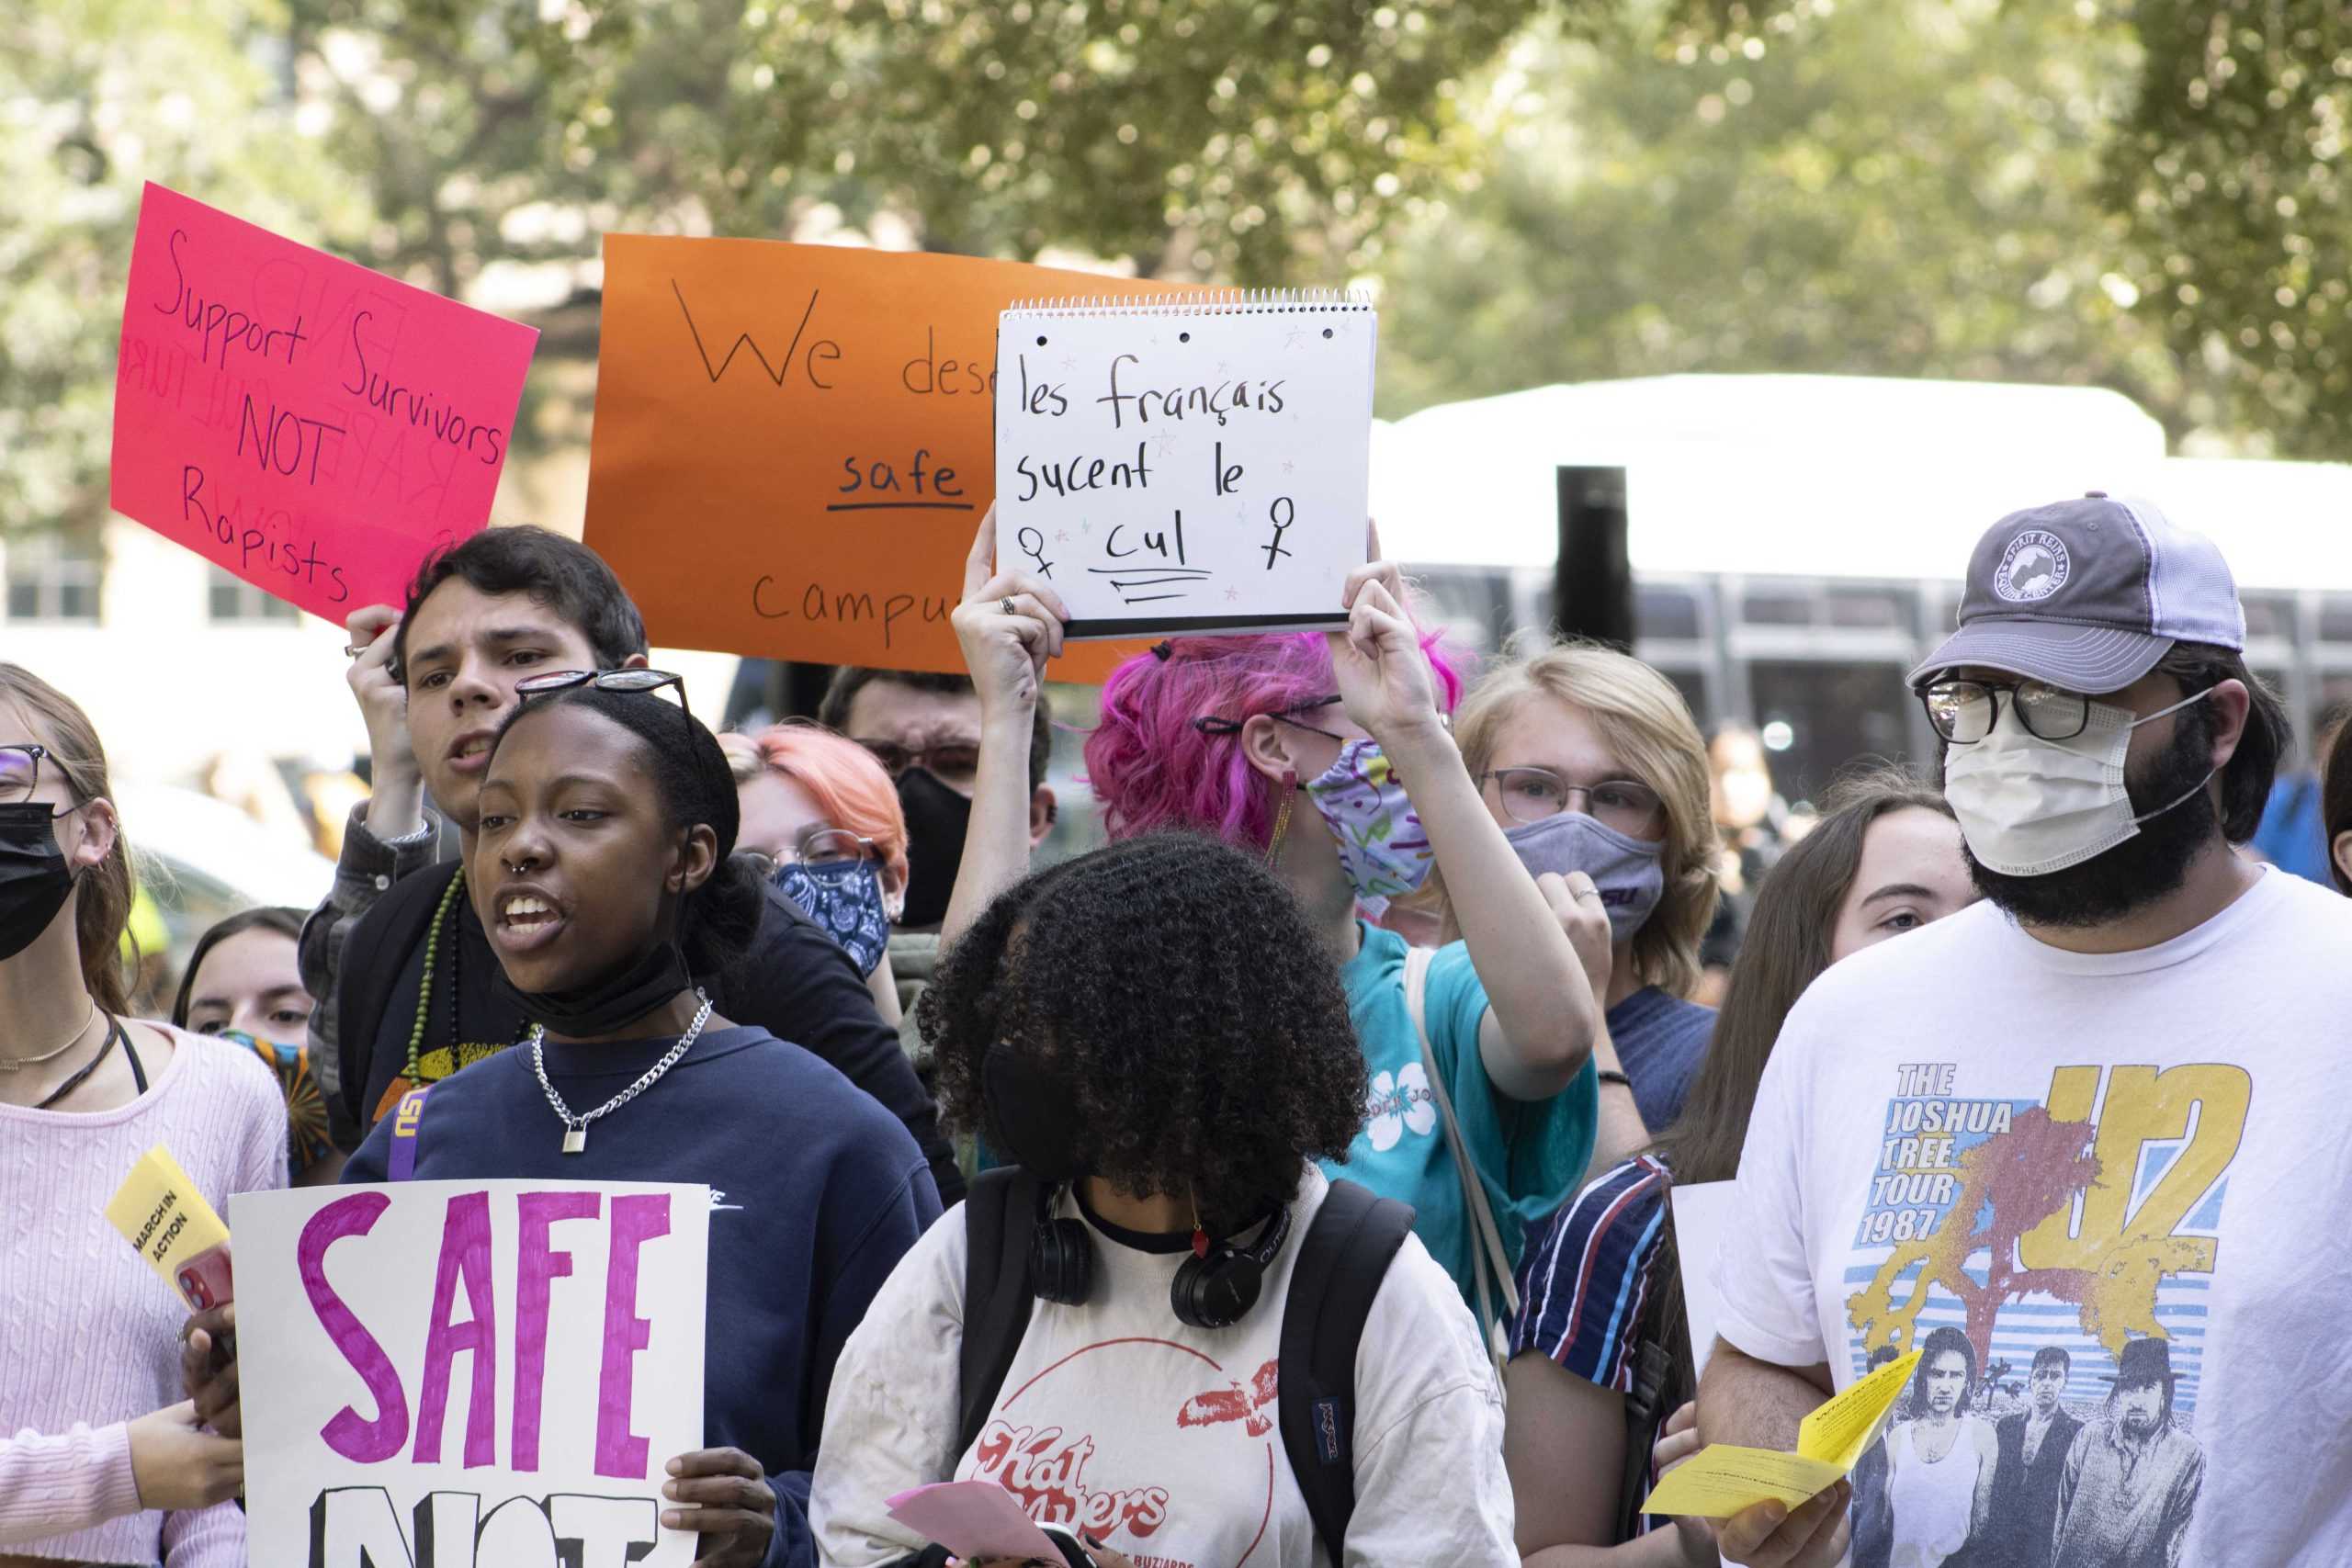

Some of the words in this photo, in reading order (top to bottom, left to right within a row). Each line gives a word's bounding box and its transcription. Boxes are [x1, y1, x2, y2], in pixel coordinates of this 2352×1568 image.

[154, 229, 308, 371] Support
[343, 310, 503, 466] Survivors
[672, 277, 842, 389] We
[902, 324, 996, 395] des
[1019, 354, 1069, 417] les
[1096, 354, 1286, 429] français
[236, 392, 347, 486] NOT
[838, 450, 964, 497] safe
[1017, 441, 1153, 502] sucent
[1216, 441, 1244, 497] le
[183, 465, 349, 604] Rapists
[1106, 509, 1185, 567] cul
[2007, 533, 2036, 562] SPIRIT
[2039, 534, 2066, 562] REINS
[752, 575, 961, 649] Campu
[1897, 1064, 1957, 1097] THE
[1886, 1099, 2014, 1135] JOSHUA
[1881, 1136, 1957, 1172] TREE
[2018, 1062, 2254, 1275] U2
[1871, 1172, 1956, 1208] TOUR
[131, 1202, 168, 1254] MARCH
[162, 1189, 177, 1210] IN
[152, 1211, 188, 1263] ACTION
[1860, 1208, 1938, 1246] 1987
[297, 1190, 672, 1481] SAFE
